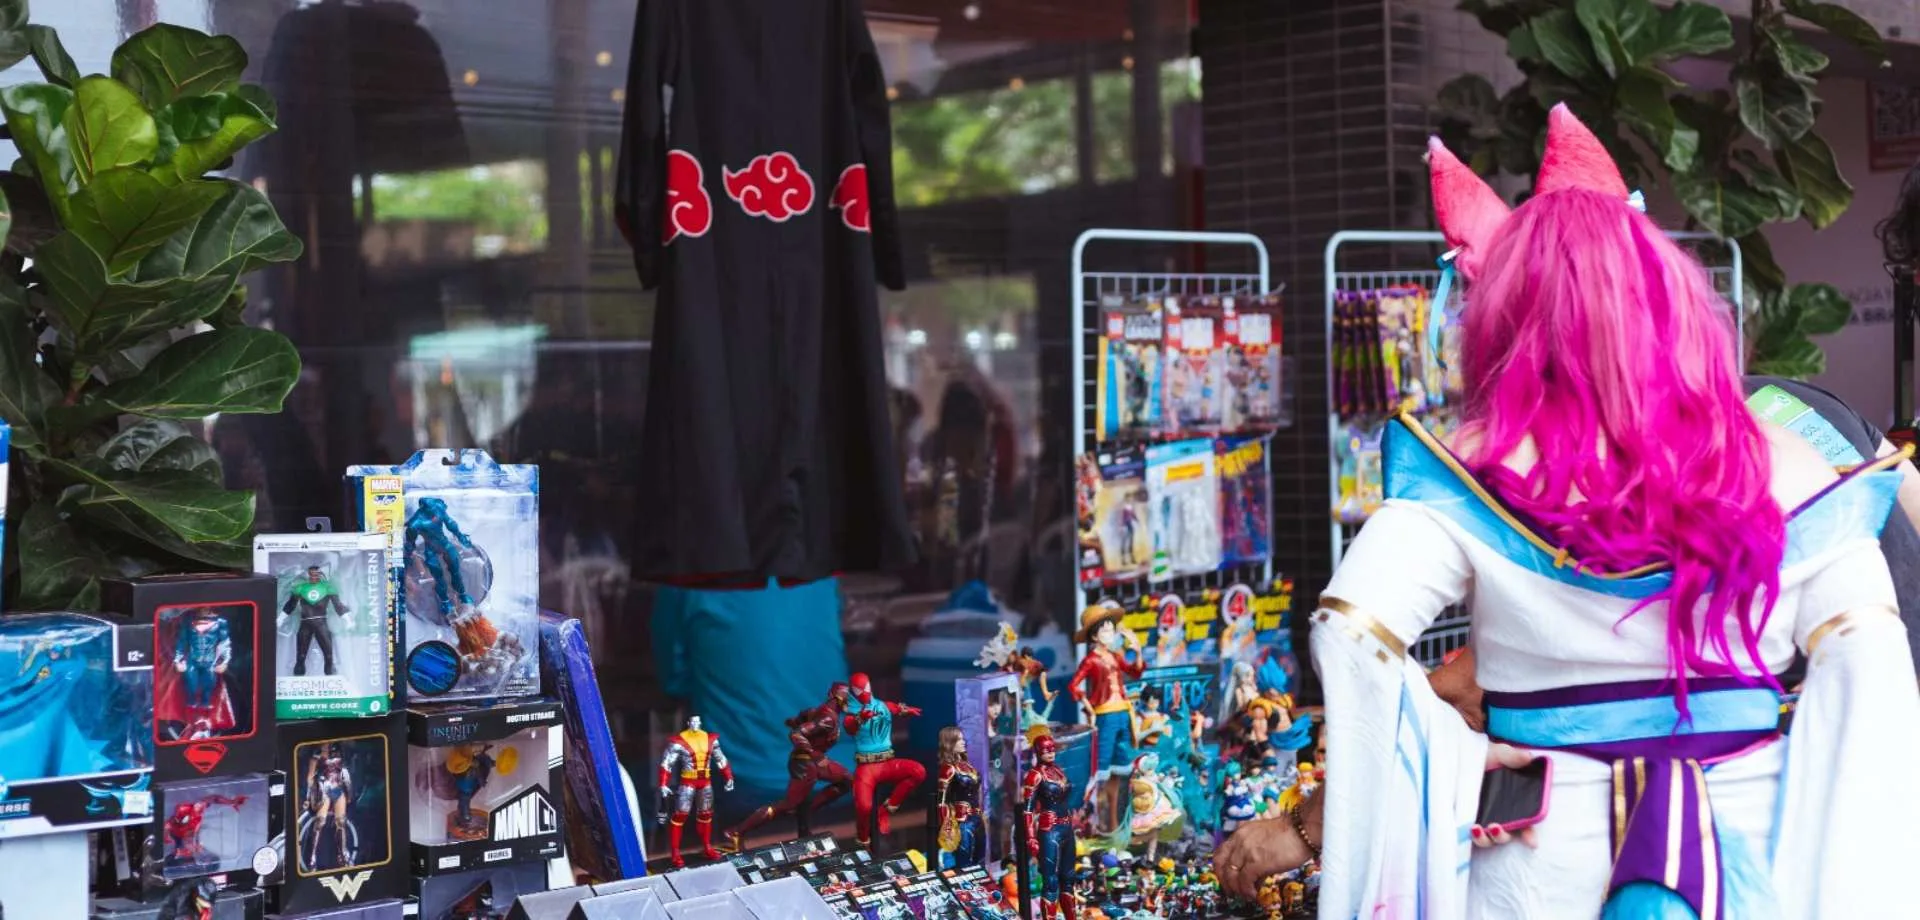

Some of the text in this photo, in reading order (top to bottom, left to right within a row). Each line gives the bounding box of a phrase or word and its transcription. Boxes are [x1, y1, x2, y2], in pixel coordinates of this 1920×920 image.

[367, 552, 379, 627] LANTERN
[369, 632, 381, 687] GREEN
[289, 679, 344, 691] COMICS
[291, 703, 327, 711] DARWYN
[506, 710, 556, 723] DOCTOR STRANGE
[433, 722, 479, 738] INFINITY
